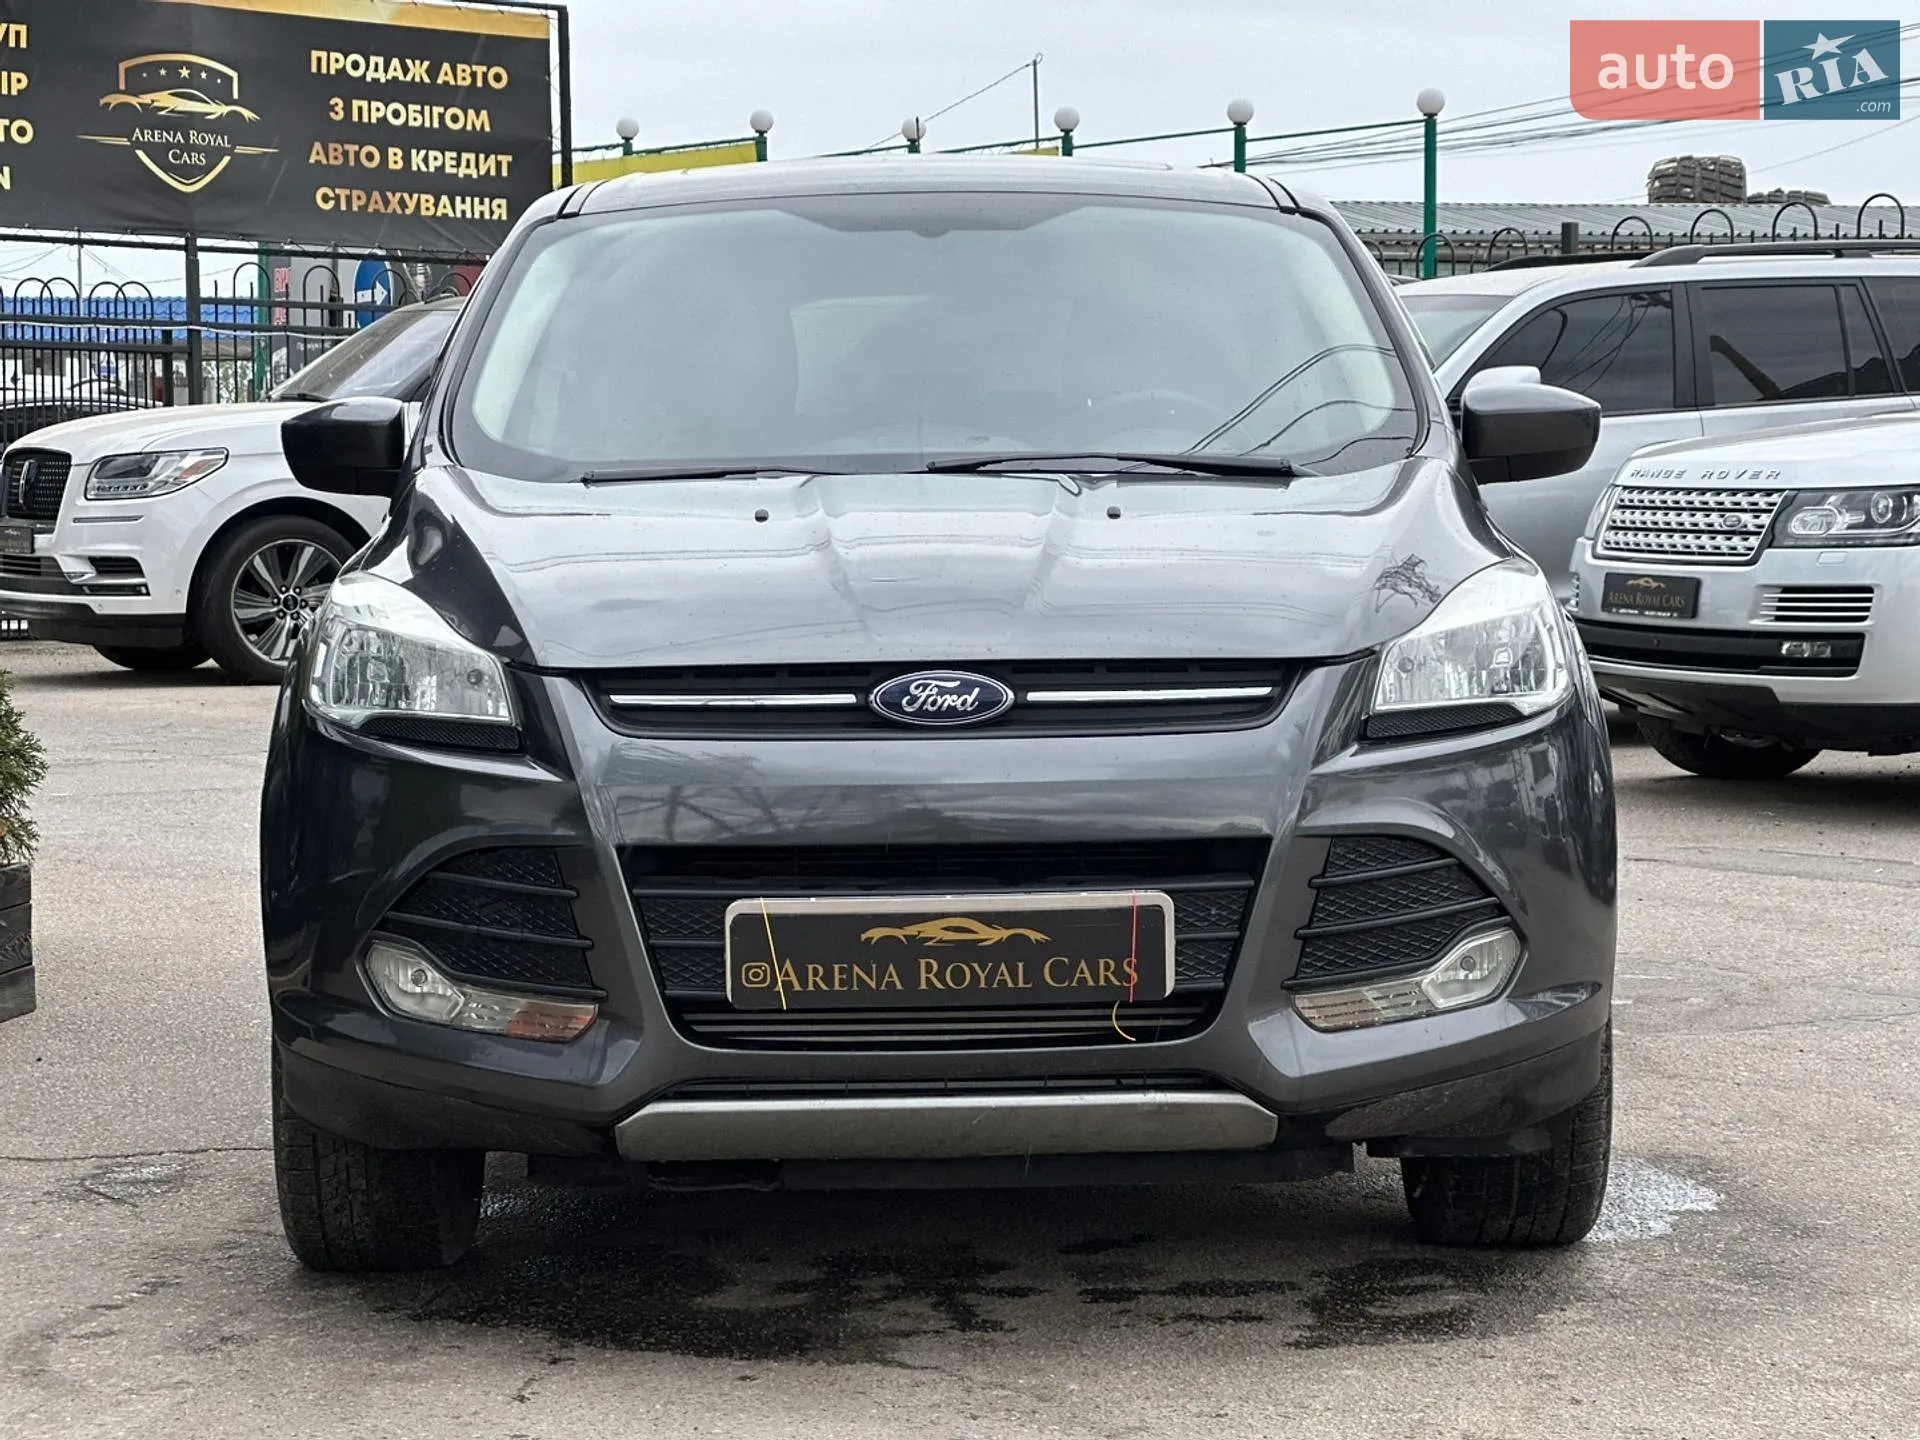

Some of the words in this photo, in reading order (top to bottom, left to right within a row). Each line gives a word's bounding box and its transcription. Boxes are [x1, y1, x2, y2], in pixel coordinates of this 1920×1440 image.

[311, 50, 430, 83] ПРОДАЖ
[436, 62, 508, 89] АВТО
[328, 97, 344, 121] З
[352, 99, 491, 132] ПРОБІГОМ
[132, 127, 185, 144] ARENA
[189, 130, 231, 148] ROYAL
[168, 149, 206, 166] CARS
[309, 142, 381, 169] АВТО
[387, 147, 404, 170] В
[411, 148, 513, 179] КРЕДИТ
[315, 187, 508, 221] СТРАХУВАННЯ
[1630, 468, 1687, 479] RANGE
[1700, 468, 1782, 480] ROVER
[1662, 594, 1686, 608] CARS
[901, 680, 980, 712] Ford
[773, 956, 904, 992] ARENA
[917, 957, 1032, 990] ROYAL
[1043, 956, 1139, 988] CARS
